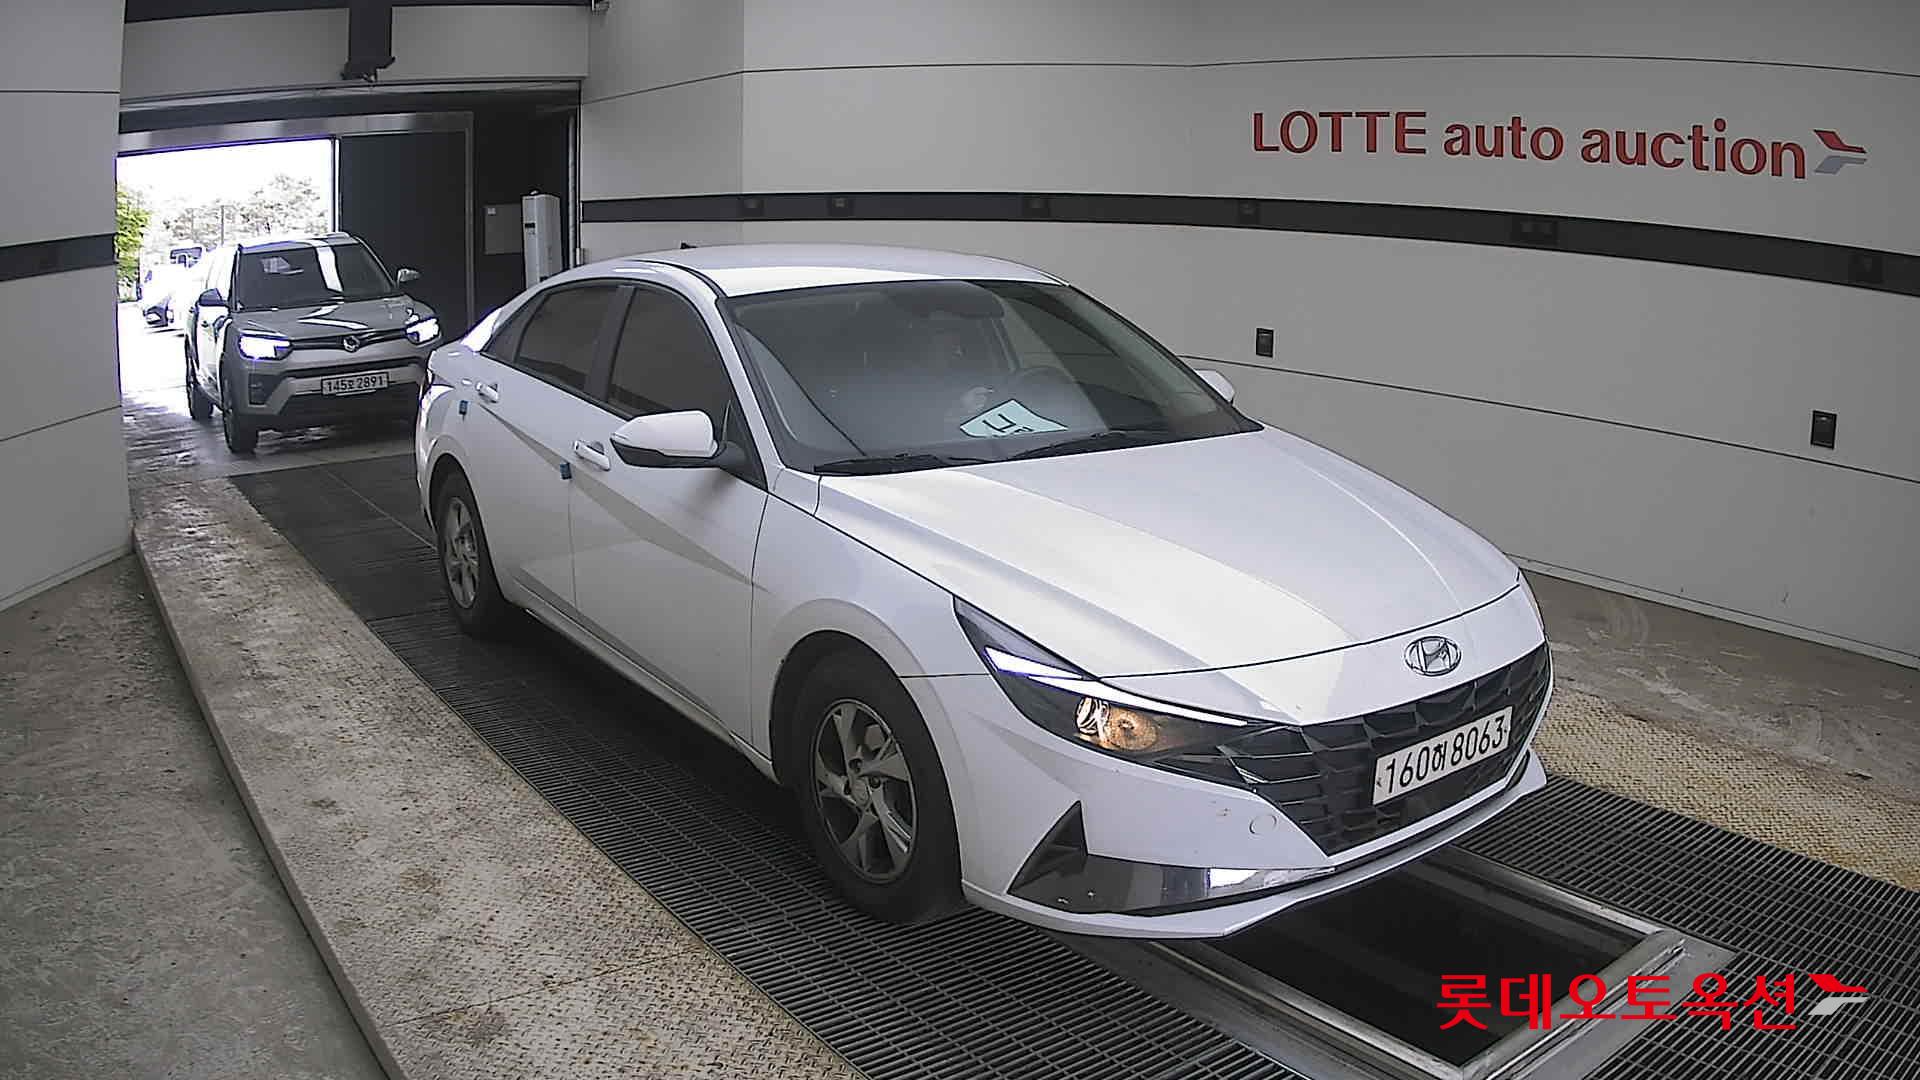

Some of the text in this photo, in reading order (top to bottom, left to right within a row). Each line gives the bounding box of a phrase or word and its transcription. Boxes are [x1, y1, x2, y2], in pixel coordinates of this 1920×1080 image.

[1252, 111, 1806, 179] LOTTE auto auction
[356, 375, 384, 389] 2891
[1385, 715, 1506, 794] 160허 8063
